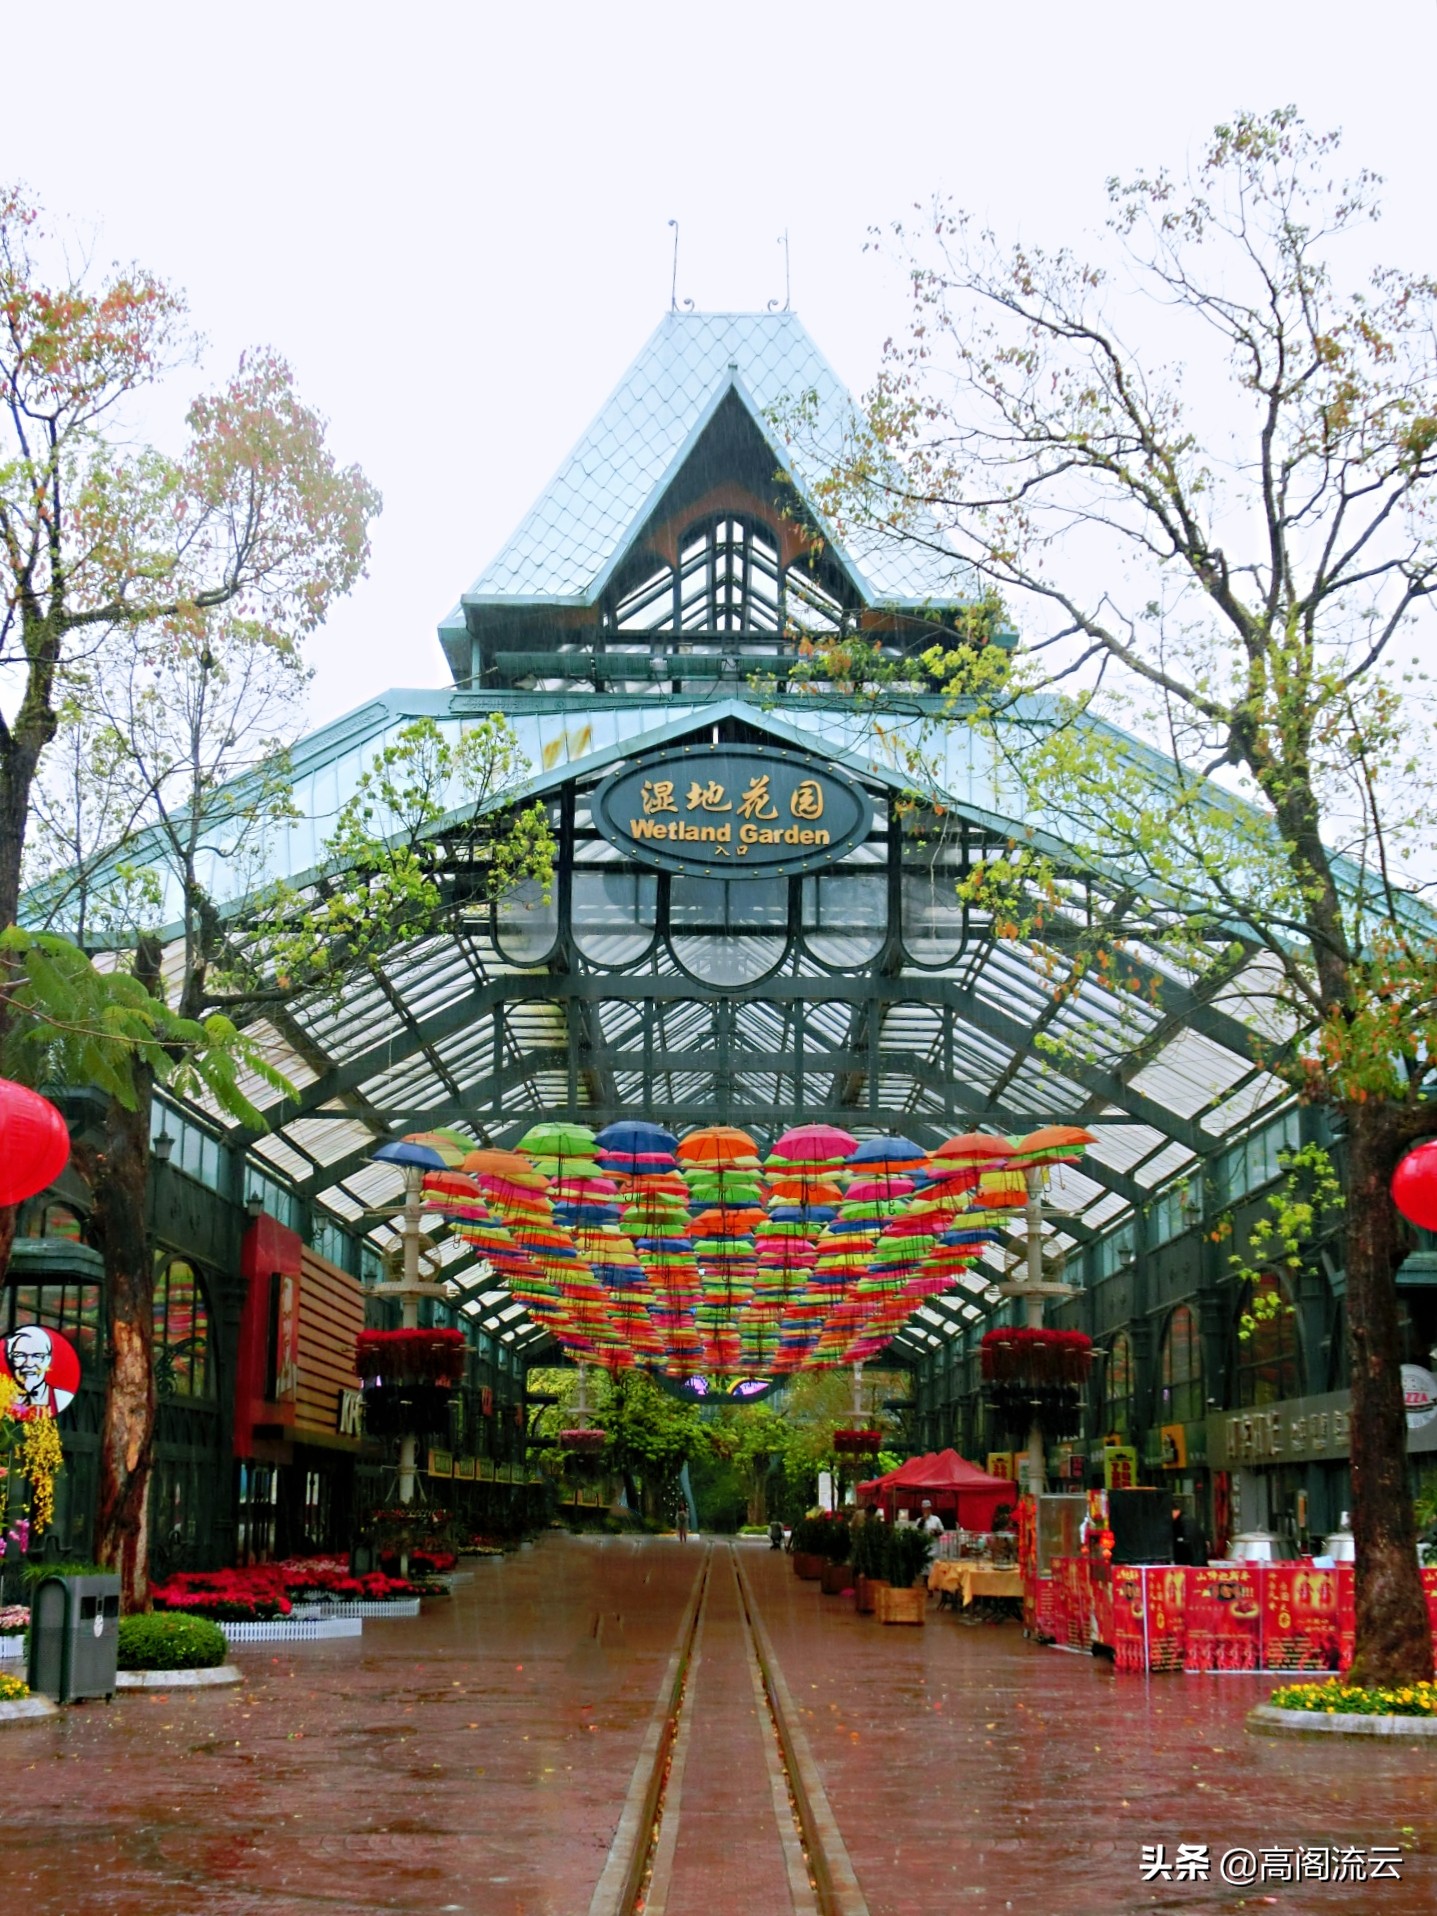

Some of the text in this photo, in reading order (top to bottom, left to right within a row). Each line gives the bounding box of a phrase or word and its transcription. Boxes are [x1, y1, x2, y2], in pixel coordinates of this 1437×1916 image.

[641, 774, 825, 820] 湿地花园
[630, 819, 830, 845] Wetland Garden
[714, 844, 748, 856] 入口
[1405, 1391, 1429, 1404] ZZA
